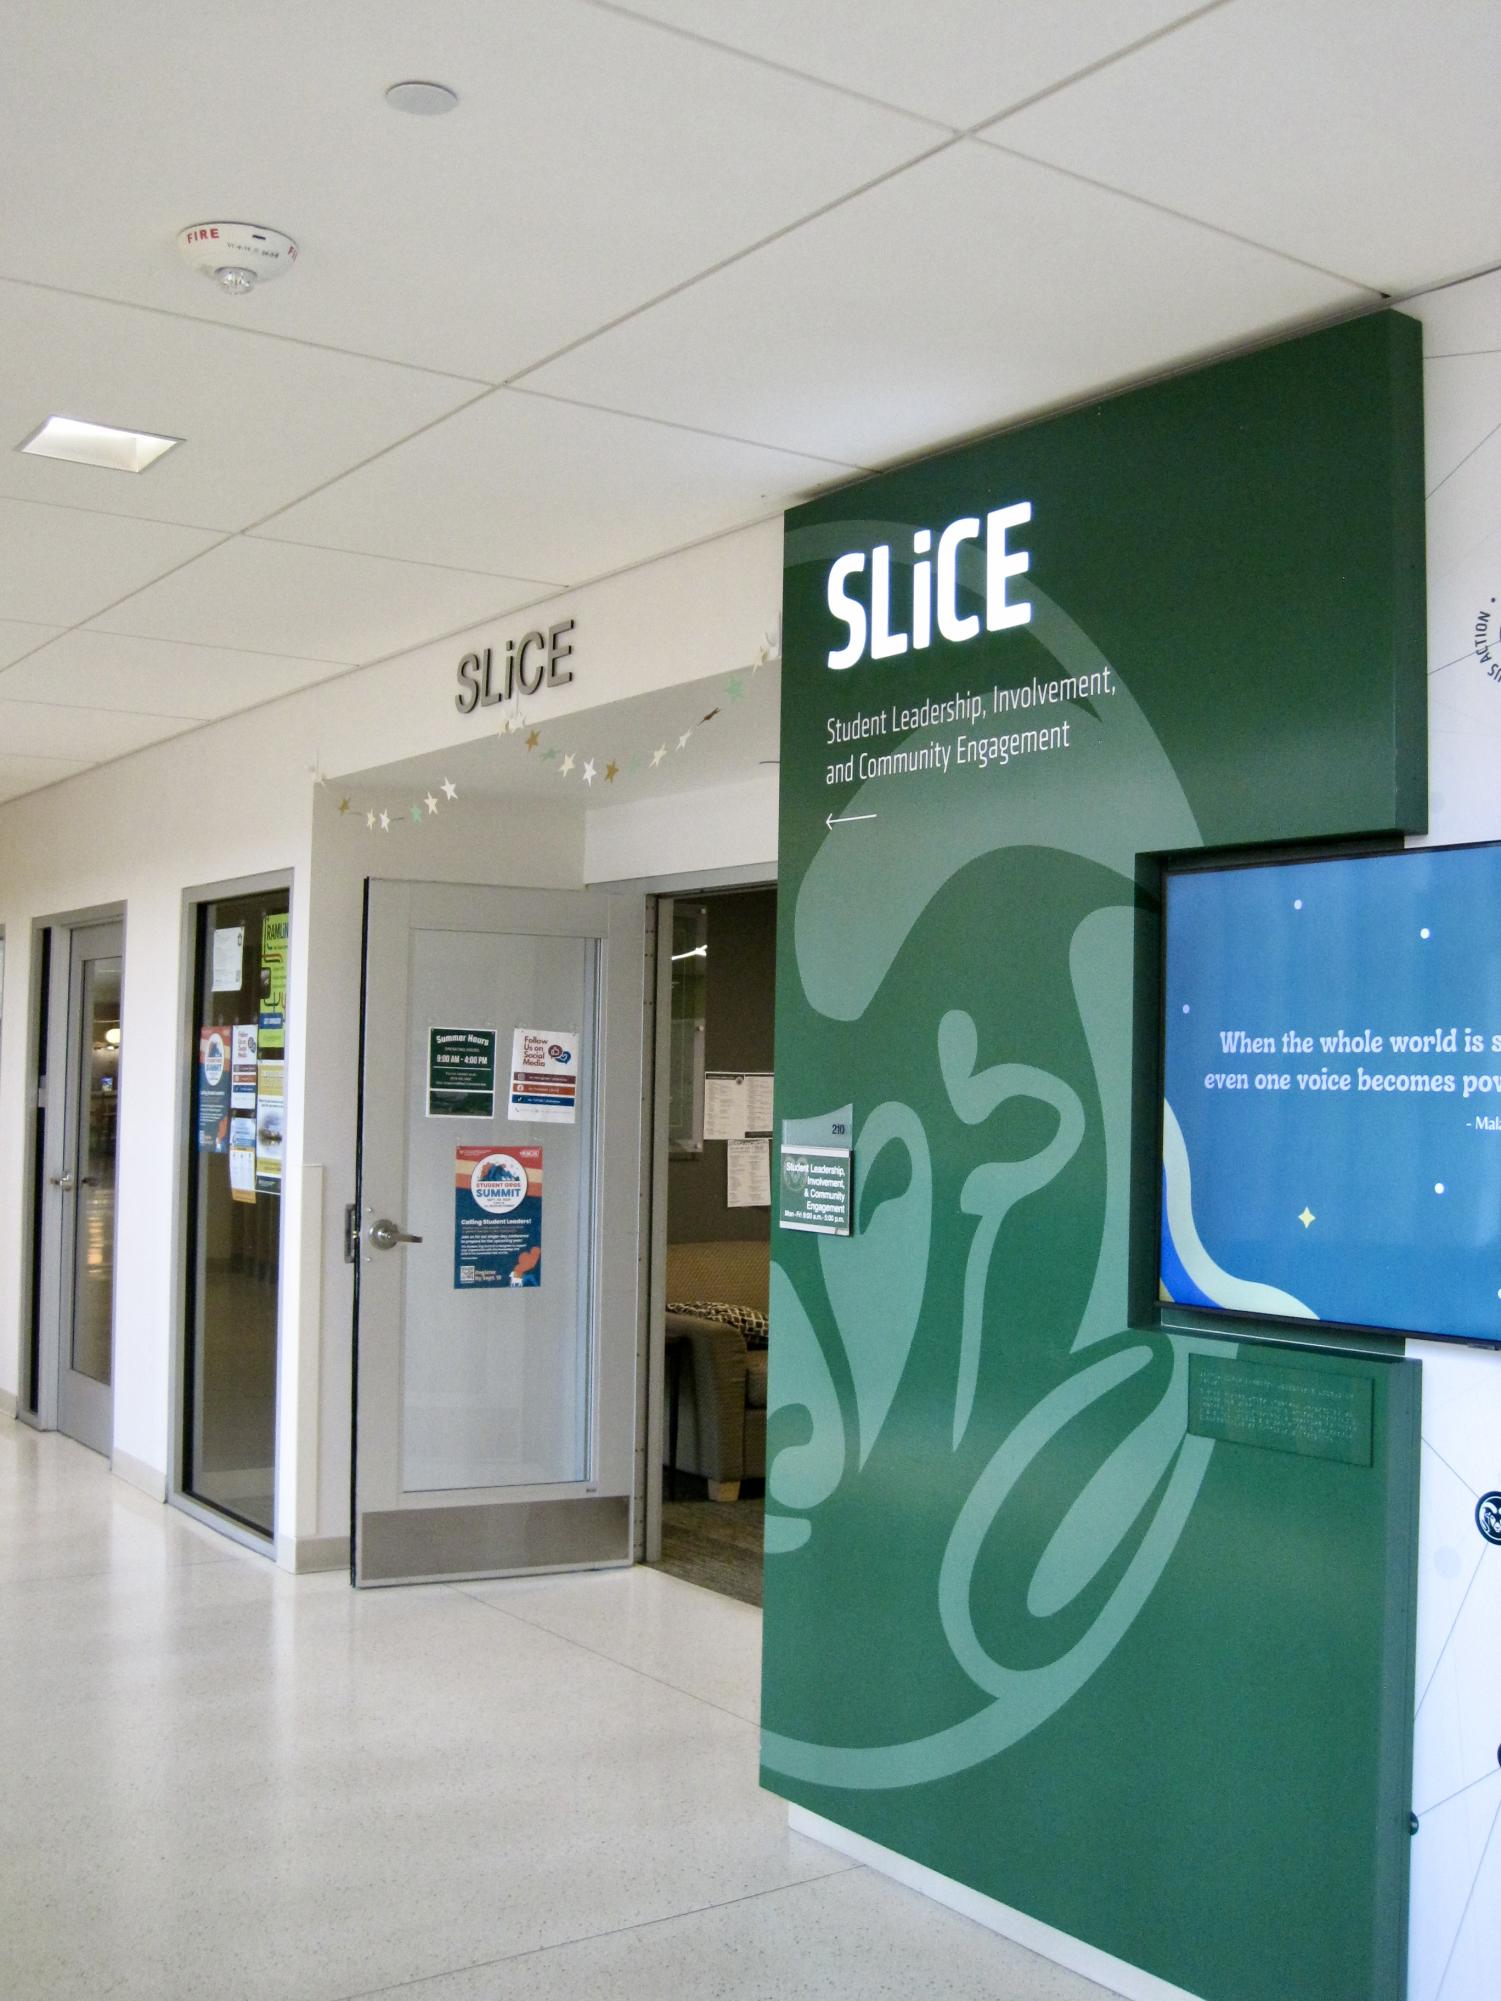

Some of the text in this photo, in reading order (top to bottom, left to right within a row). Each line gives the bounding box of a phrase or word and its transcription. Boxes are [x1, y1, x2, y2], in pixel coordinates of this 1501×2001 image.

[187, 228, 219, 244] FIRE
[827, 501, 1032, 671] SLiCE
[1474, 610, 1492, 664] ACTION
[455, 619, 574, 714] SLiCE
[827, 665, 1116, 744] Student Leadership, Involvement,
[826, 720, 1070, 785] and Community Engagement
[436, 1034, 489, 1046] Summer Hours
[524, 1035, 548, 1044] Follow
[1219, 1030, 1276, 1054] When
[1281, 1030, 1314, 1053] the
[1320, 1029, 1383, 1053] whole
[1389, 1028, 1457, 1053] world
[1464, 1027, 1485, 1053] is
[478, 1056, 488, 1065] PM
[523, 1051, 545, 1060] Social
[523, 1058, 545, 1067] Media
[1204, 1072, 1249, 1090] even
[1255, 1073, 1291, 1091] one
[1297, 1067, 1352, 1091] voice
[1357, 1067, 1456, 1093] becomes
[832, 1124, 845, 1135] 210
[786, 1161, 809, 1173] Student
[476, 1188, 521, 1198] SUMMIT
[810, 1188, 845, 1203] Community
[806, 1200, 845, 1214] Engagement
[461, 1218, 482, 1227] Calling
